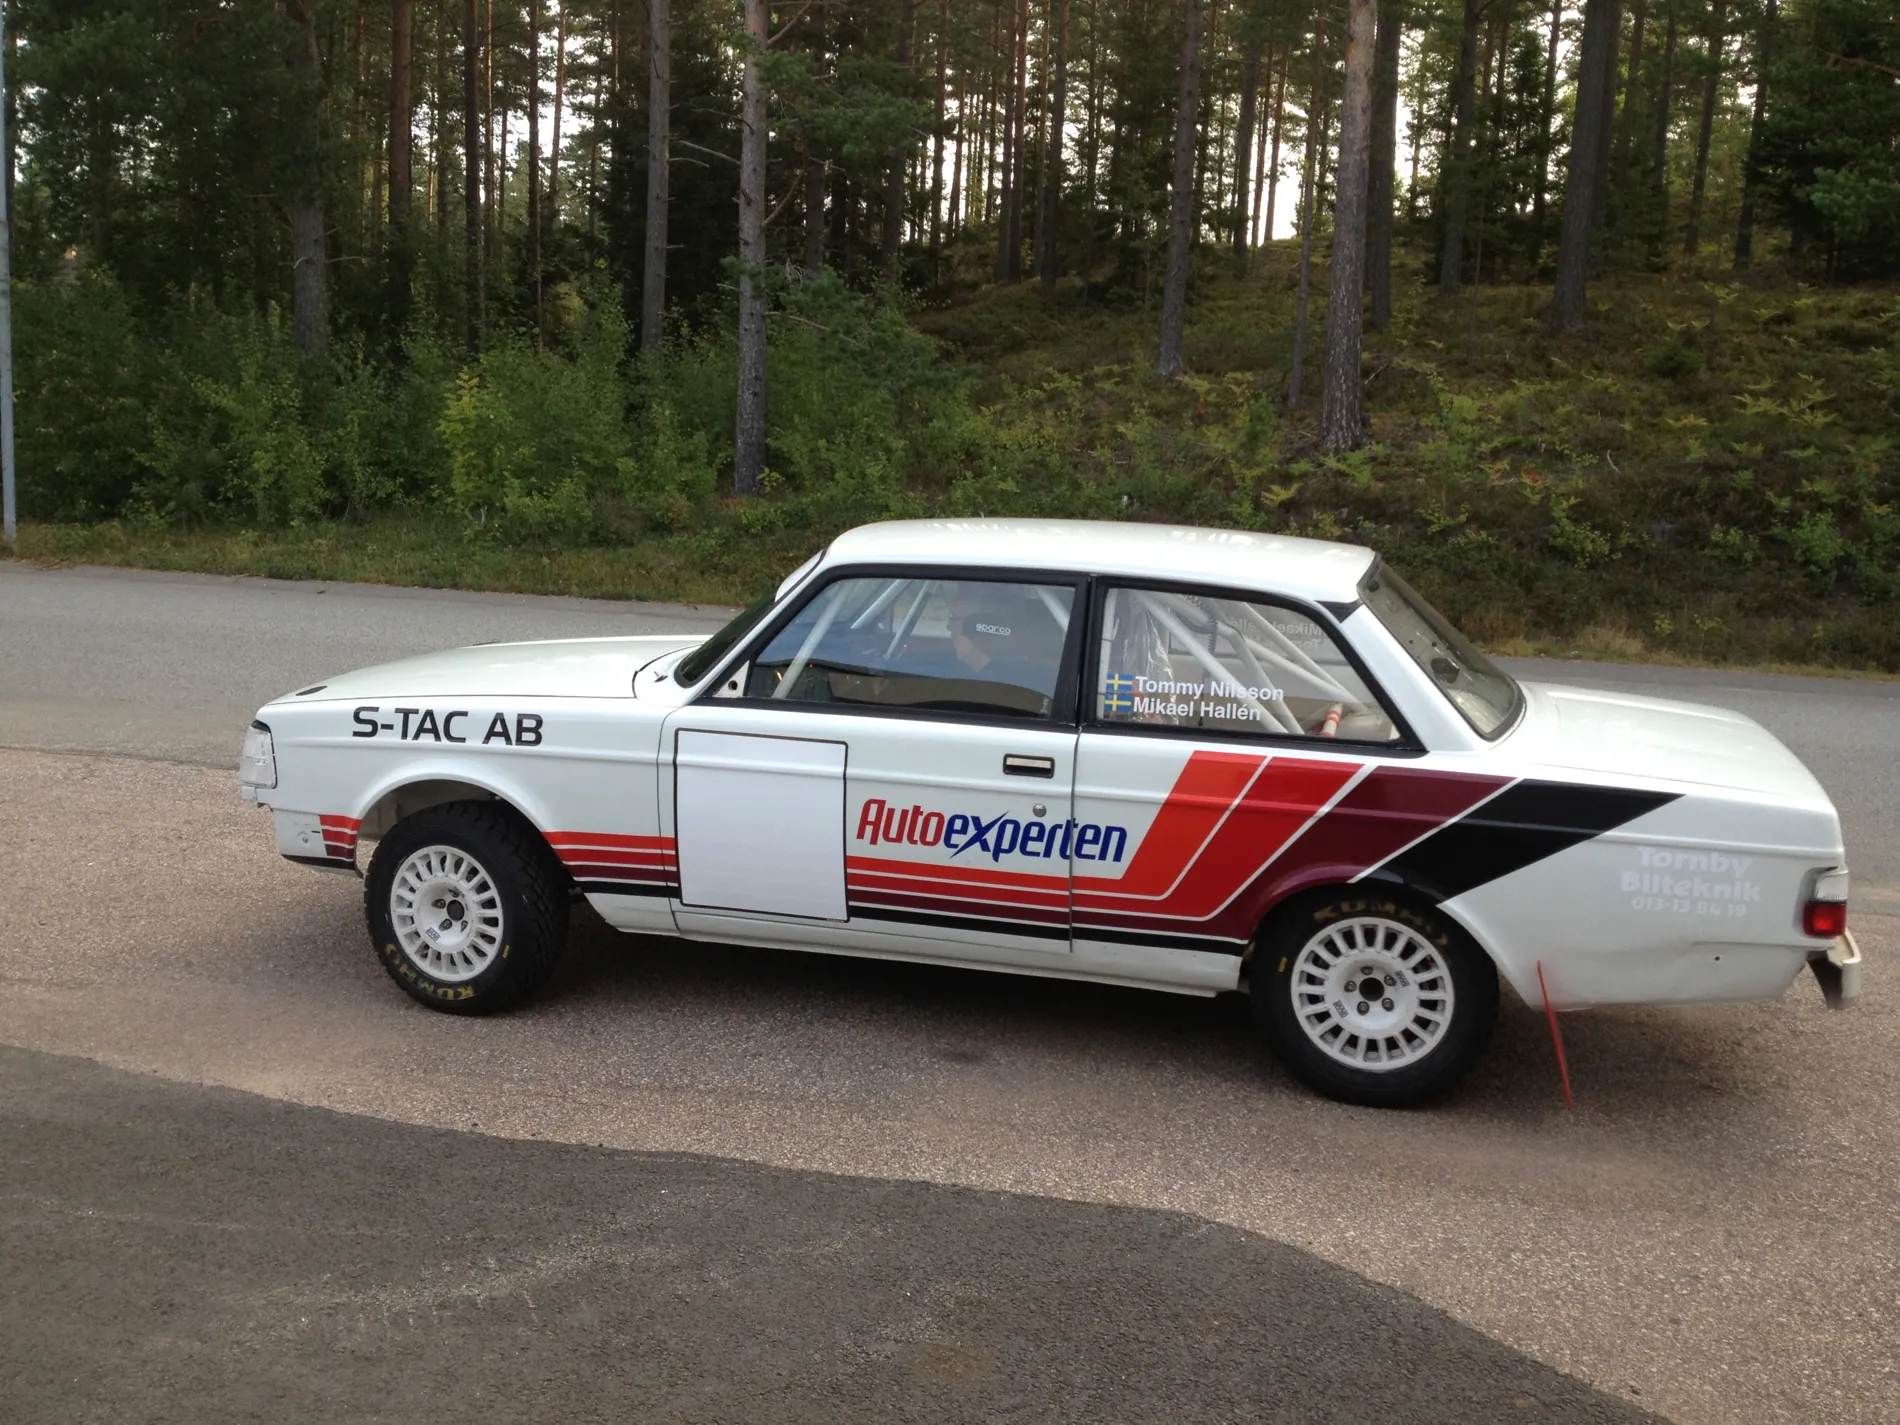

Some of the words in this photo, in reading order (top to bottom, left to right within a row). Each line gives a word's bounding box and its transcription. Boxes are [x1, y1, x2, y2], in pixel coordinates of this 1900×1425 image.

[975, 623, 1011, 636] sparco
[1135, 676, 1204, 699] Tommy
[1210, 681, 1284, 701] Nilsson
[1133, 697, 1194, 717] Mikael
[1200, 702, 1261, 721] Hallén
[352, 706, 469, 743] S-TAC
[482, 712, 543, 746] AB
[856, 798, 1127, 863] Autoexperten
[1637, 847, 1752, 878] Tornby
[1620, 870, 1761, 902] Bilteknik
